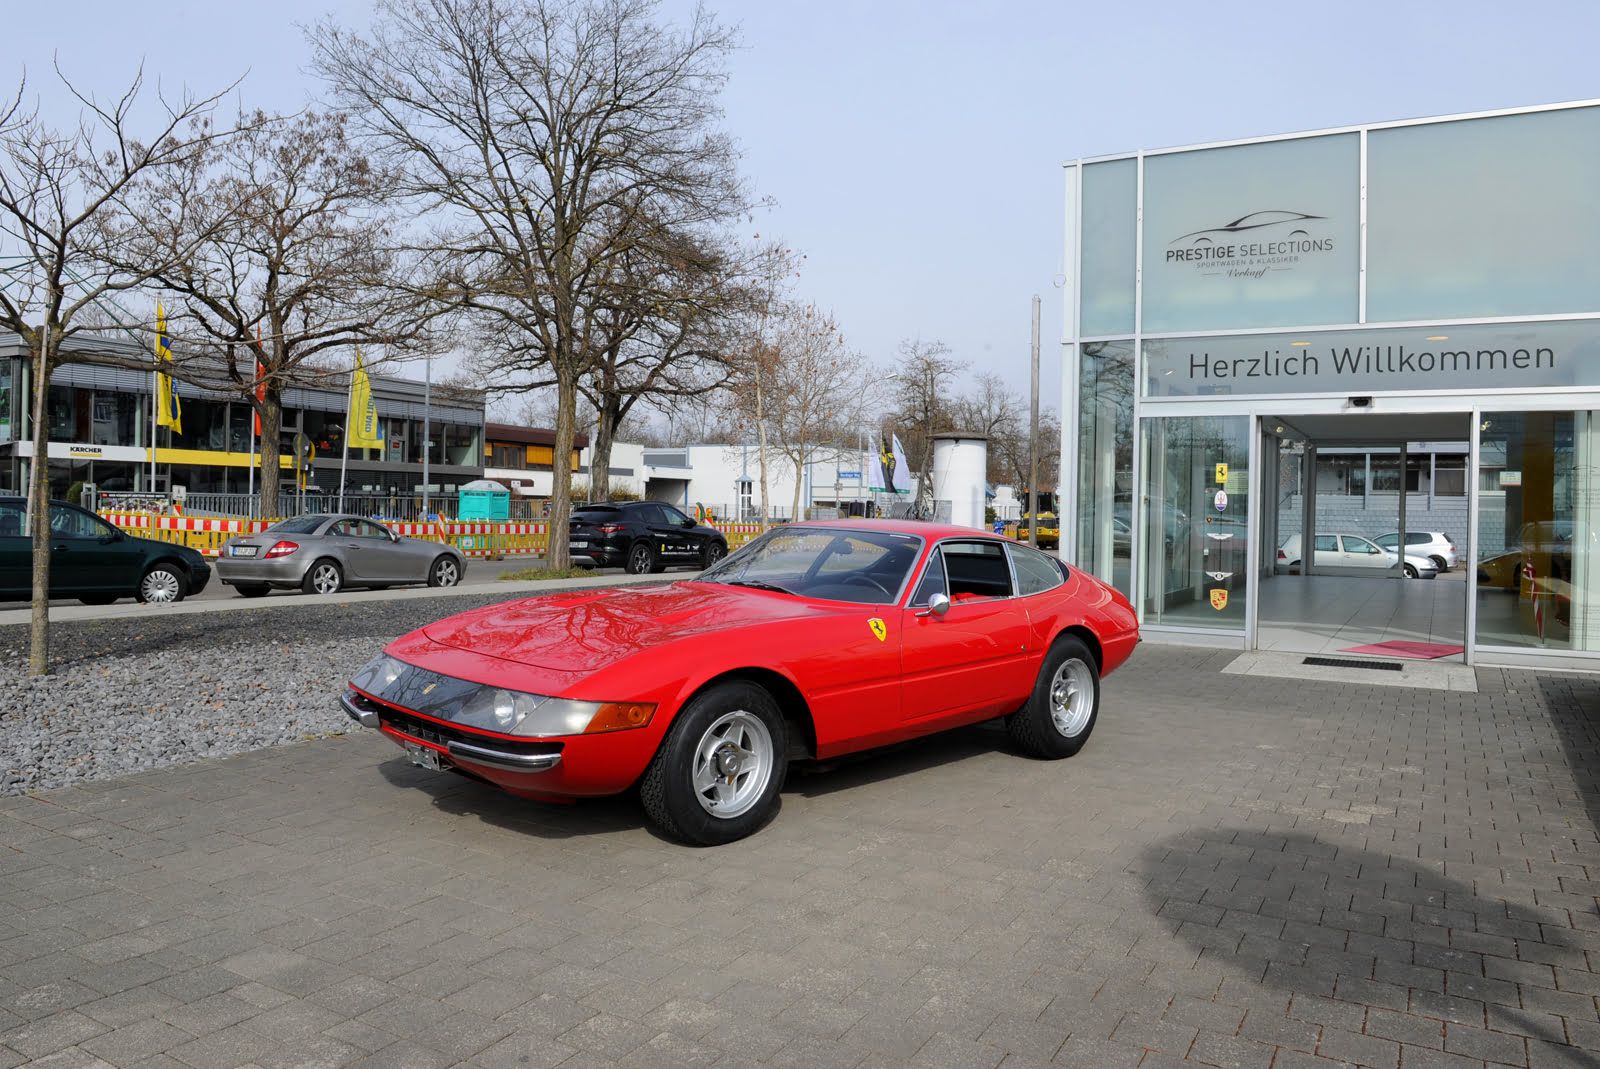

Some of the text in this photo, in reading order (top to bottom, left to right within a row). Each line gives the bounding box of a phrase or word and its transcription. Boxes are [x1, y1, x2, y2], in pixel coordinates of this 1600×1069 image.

[1166, 239, 1333, 262] PRESTIGE SELECTIONS
[1196, 260, 1246, 269] SPORTWAGEN
[1256, 255, 1299, 265] KLASSIKER
[1190, 346, 1555, 379] Herzlich Willkommen
[70, 446, 102, 454] KÄRCHER
